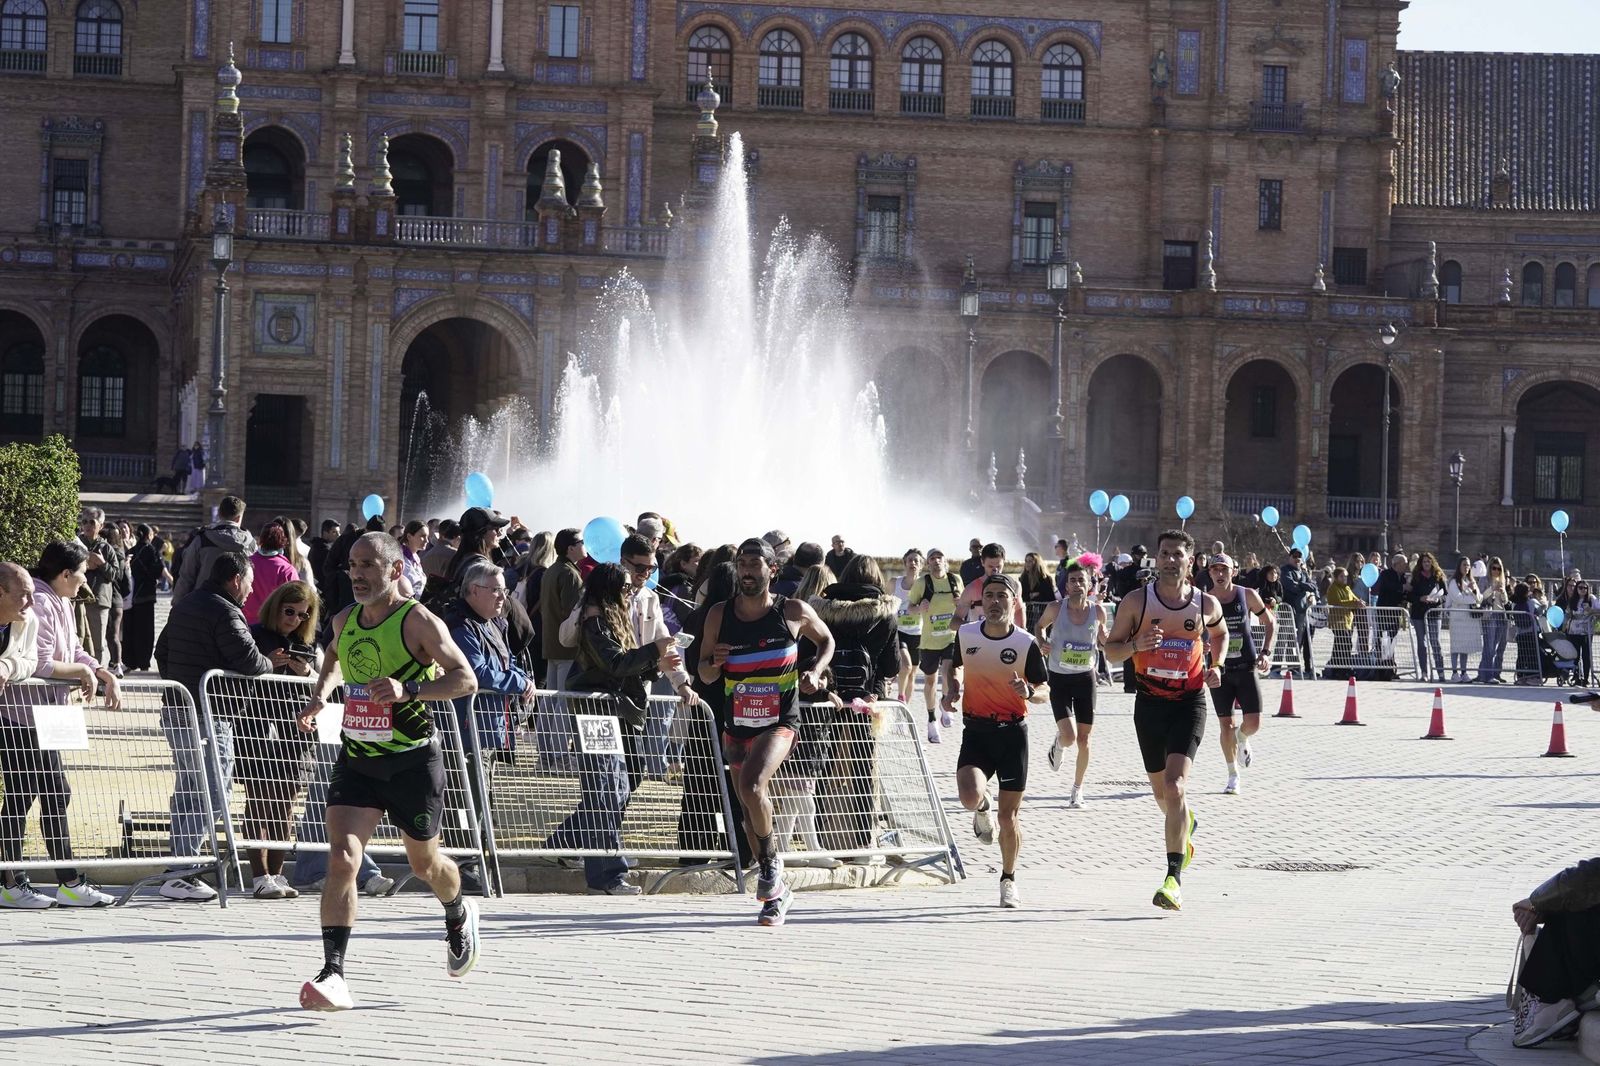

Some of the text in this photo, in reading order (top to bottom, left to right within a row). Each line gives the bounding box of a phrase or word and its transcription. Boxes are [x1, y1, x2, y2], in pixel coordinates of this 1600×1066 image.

[748, 685, 774, 693] ZURICH
[355, 704, 368, 713] 784
[743, 707, 770, 717] MIGUE
[343, 714, 390, 729] PEPPUZZO
